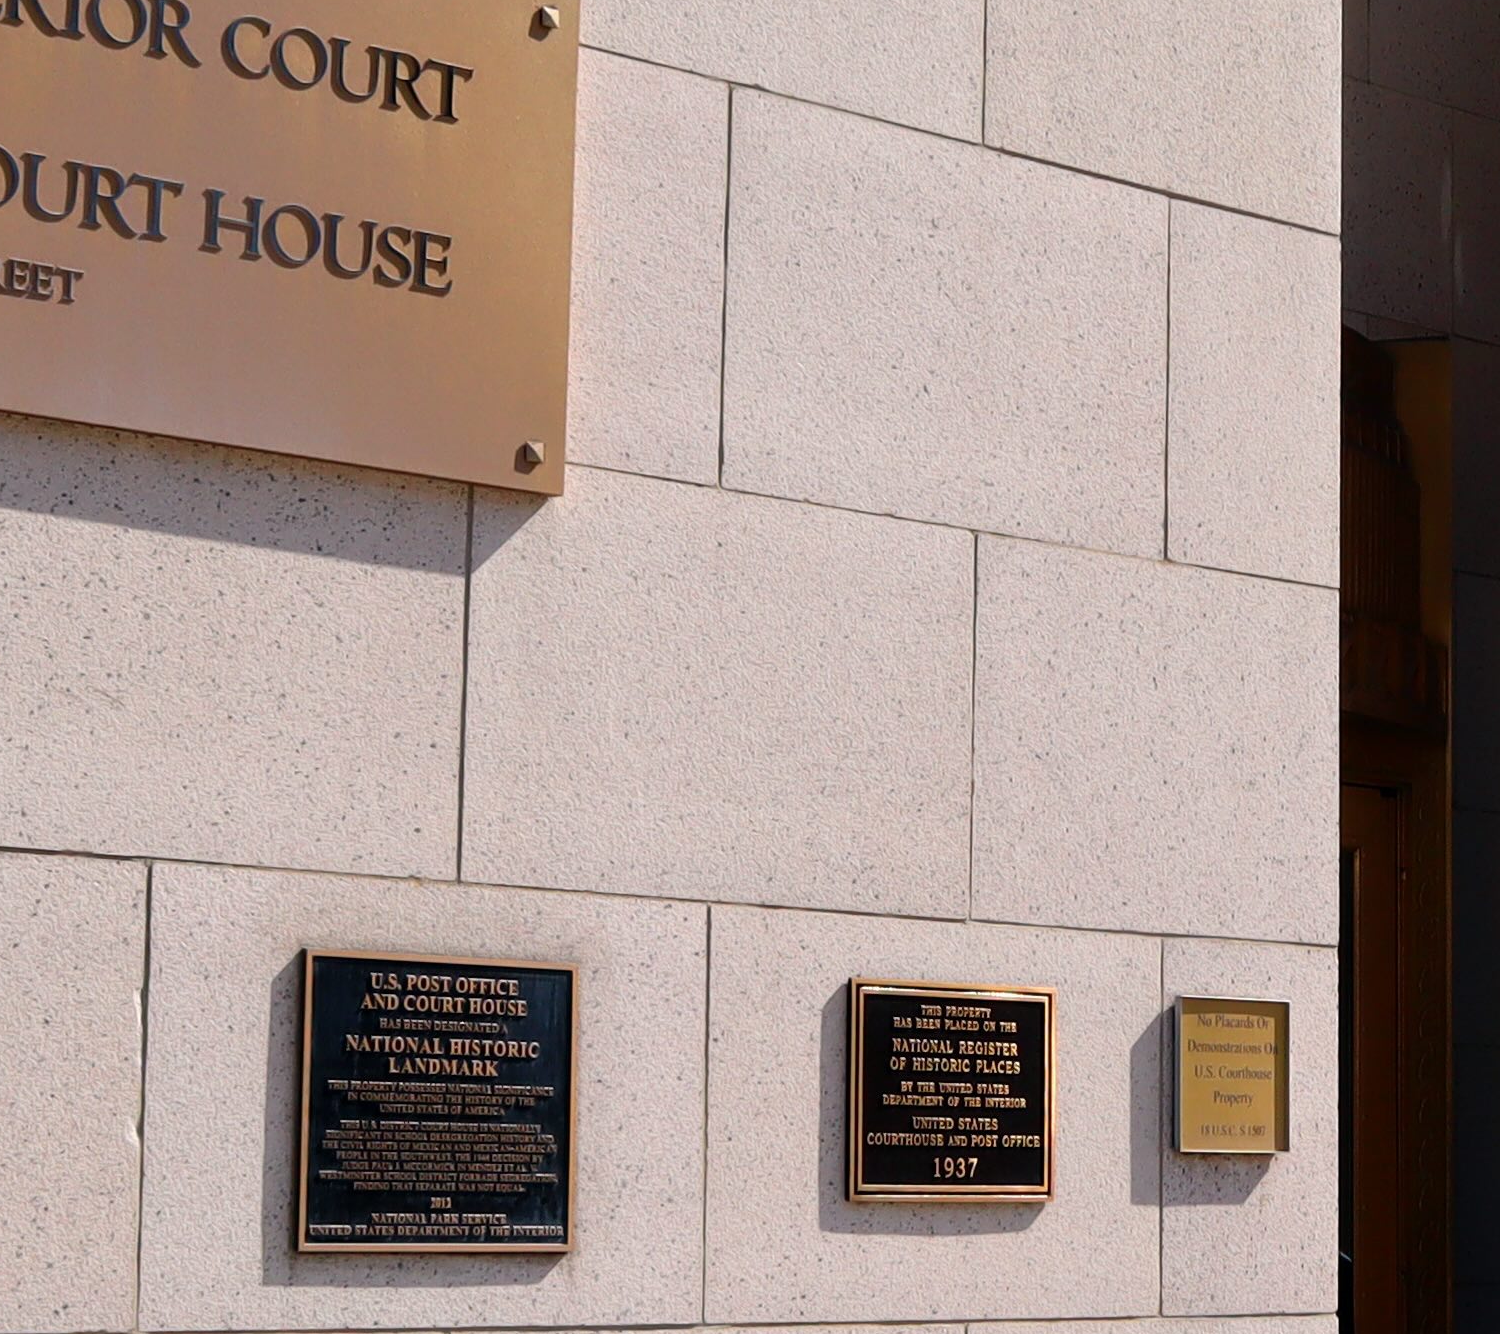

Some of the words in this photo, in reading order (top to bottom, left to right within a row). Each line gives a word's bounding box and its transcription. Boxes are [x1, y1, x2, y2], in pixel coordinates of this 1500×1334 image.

[220, 13, 475, 125] COURT
[199, 189, 454, 298] HOUSE
[370, 973, 401, 990] U.S.
[406, 975, 451, 992] POST
[456, 977, 519, 996] OFFICE
[361, 993, 399, 1010] AND
[404, 995, 464, 1013] COURT
[469, 998, 527, 1016] HOUSE
[921, 1005, 941, 1016] THIS
[946, 1006, 991, 1018] PROPERTY
[380, 1018, 400, 1029] HAS
[404, 1019, 431, 1030] BEEN
[434, 1021, 499, 1032] DESIGNATED
[502, 1025, 508, 1033] A
[893, 1017, 912, 1028] HAS
[916, 1017, 940, 1029] BEEN
[945, 1019, 979, 1031] PLACED
[983, 1021, 996, 1032] ON
[1000, 1022, 1017, 1032] THE
[1197, 1015, 1212, 1028] No
[1215, 1016, 1254, 1029] Placards
[1257, 1017, 1268, 1029] Or
[346, 1034, 444, 1054] NATIONAL
[450, 1038, 540, 1058] HISTORIC
[892, 1038, 953, 1054] NATIONAL
[959, 1041, 1018, 1056] REGISTER
[1188, 1039, 1262, 1054] Demonstrations
[1264, 1044, 1277, 1055] On
[389, 1057, 498, 1077] LANDMARK
[890, 1057, 906, 1071] OF
[913, 1058, 970, 1072] HISTORIC
[976, 1060, 1020, 1074] PLACES
[1195, 1066, 1215, 1078] U.S.
[1218, 1067, 1272, 1080] Courthouse
[327, 1080, 348, 1089] THIS
[351, 1081, 397, 1091] PROPERTY
[399, 1082, 446, 1093] POSSESSES
[447, 1084, 492, 1094] NATIONAL
[494, 1085, 553, 1096] SIGNIFICANCE
[901, 1081, 913, 1092] BY
[917, 1082, 935, 1093] THE
[939, 1083, 973, 1094] UNITED
[977, 1084, 1009, 1094] STATES
[348, 1092, 358, 1100] IN
[360, 1092, 443, 1103] COMMEMORATING
[446, 1095, 462, 1103] THE
[465, 1096, 503, 1104] HISTORY
[505, 1097, 515, 1105] OF
[519, 1097, 535, 1106] THE
[883, 1094, 944, 1106] DEPARTMENT
[948, 1096, 959, 1107] OF
[964, 1097, 981, 1107] THE
[985, 1097, 1026, 1108] INTERIOR
[1214, 1091, 1254, 1107] Property
[380, 1104, 414, 1113] UNITED
[417, 1105, 448, 1114] STATES
[451, 1106, 461, 1114] OF
[465, 1106, 505, 1115] AMERICA
[340, 1120, 359, 1128] THIS
[380, 1121, 419, 1130] DISTRICT
[421, 1122, 449, 1131] COURT
[481, 1123, 487, 1131] IS
[489, 1124, 541, 1133] NATIONALLY
[912, 1116, 954, 1129] UNITED
[958, 1118, 998, 1130] STATES
[326, 1130, 380, 1139] SIGNIFICANT
[396, 1132, 427, 1140] SCHOOL
[430, 1132, 498, 1143] DESEGREGATION
[501, 1134, 535, 1143] HISTORY
[867, 1133, 944, 1146] COURTHOUSE
[948, 1135, 967, 1146] AND
[971, 1134, 998, 1147] POST
[1002, 1135, 1040, 1147] OFFICE
[322, 1140, 338, 1148] THE
[341, 1141, 363, 1149] CIVIL
[366, 1141, 397, 1149] RIGHTS
[400, 1142, 410, 1150] OF
[412, 1142, 452, 1151] MEXICAN
[337, 1151, 367, 1160] PEOPLE
[371, 1151, 380, 1159] IN
[382, 1152, 398, 1160] THE
[456, 1153, 471, 1161] THE
[492, 1154, 530, 1162] DECISION
[934, 1157, 978, 1178] 1937
[319, 1170, 380, 1179] WESTMINSTER
[383, 1172, 416, 1180] SCHOOL
[419, 1172, 457, 1182] DISTRICT
[354, 1182, 389, 1190] FINDING
[391, 1182, 413, 1190] THAT
[415, 1182, 456, 1192] SEPARATE
[459, 1183, 475, 1191] WAS
[371, 1213, 427, 1224] NATIONAL
[431, 1214, 459, 1224] PARK
[462, 1214, 507, 1224] SERVICE
[309, 1225, 352, 1235] UNITED
[355, 1225, 394, 1235] STATES
[397, 1225, 469, 1236] DEPARTMENT
[473, 1226, 487, 1236] OF
[490, 1226, 510, 1236] THE
[513, 1226, 564, 1236] INTERIOR
